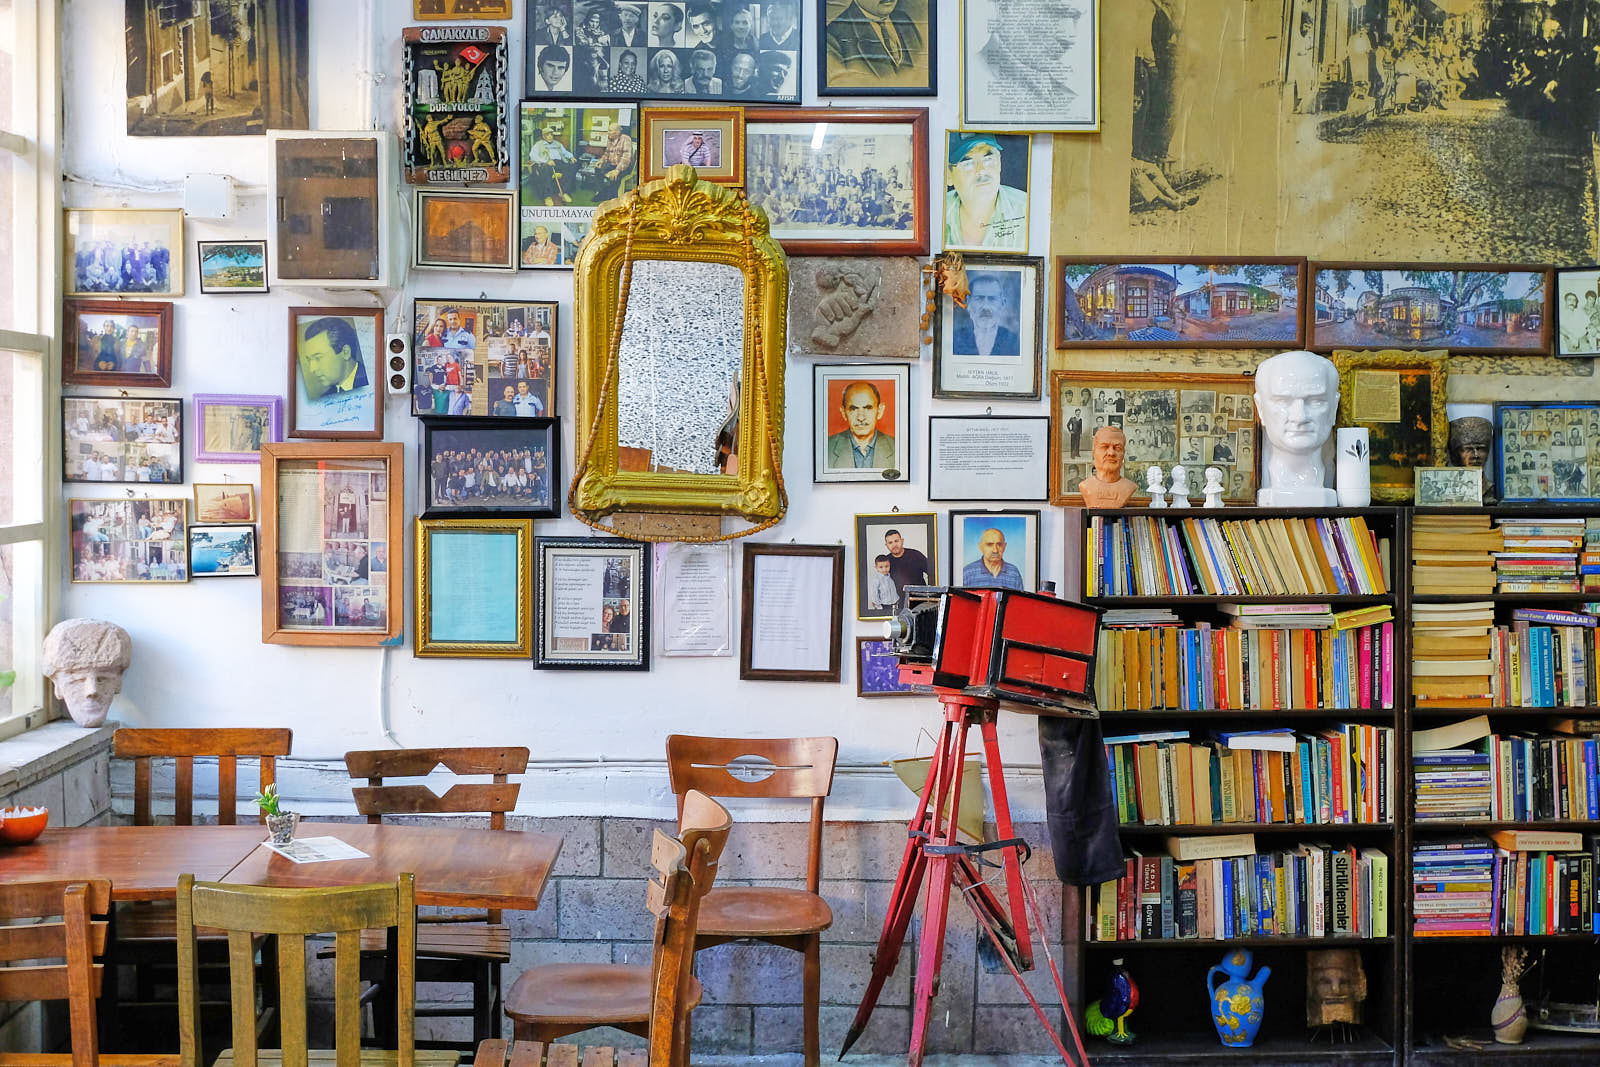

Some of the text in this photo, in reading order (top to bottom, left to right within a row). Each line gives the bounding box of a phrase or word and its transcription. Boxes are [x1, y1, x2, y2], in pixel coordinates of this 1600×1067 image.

[430, 103, 481, 112] DUR YOLCU
[1545, 613, 1588, 624] AVUKATLAR
[1336, 857, 1350, 930] sürüklenenler
